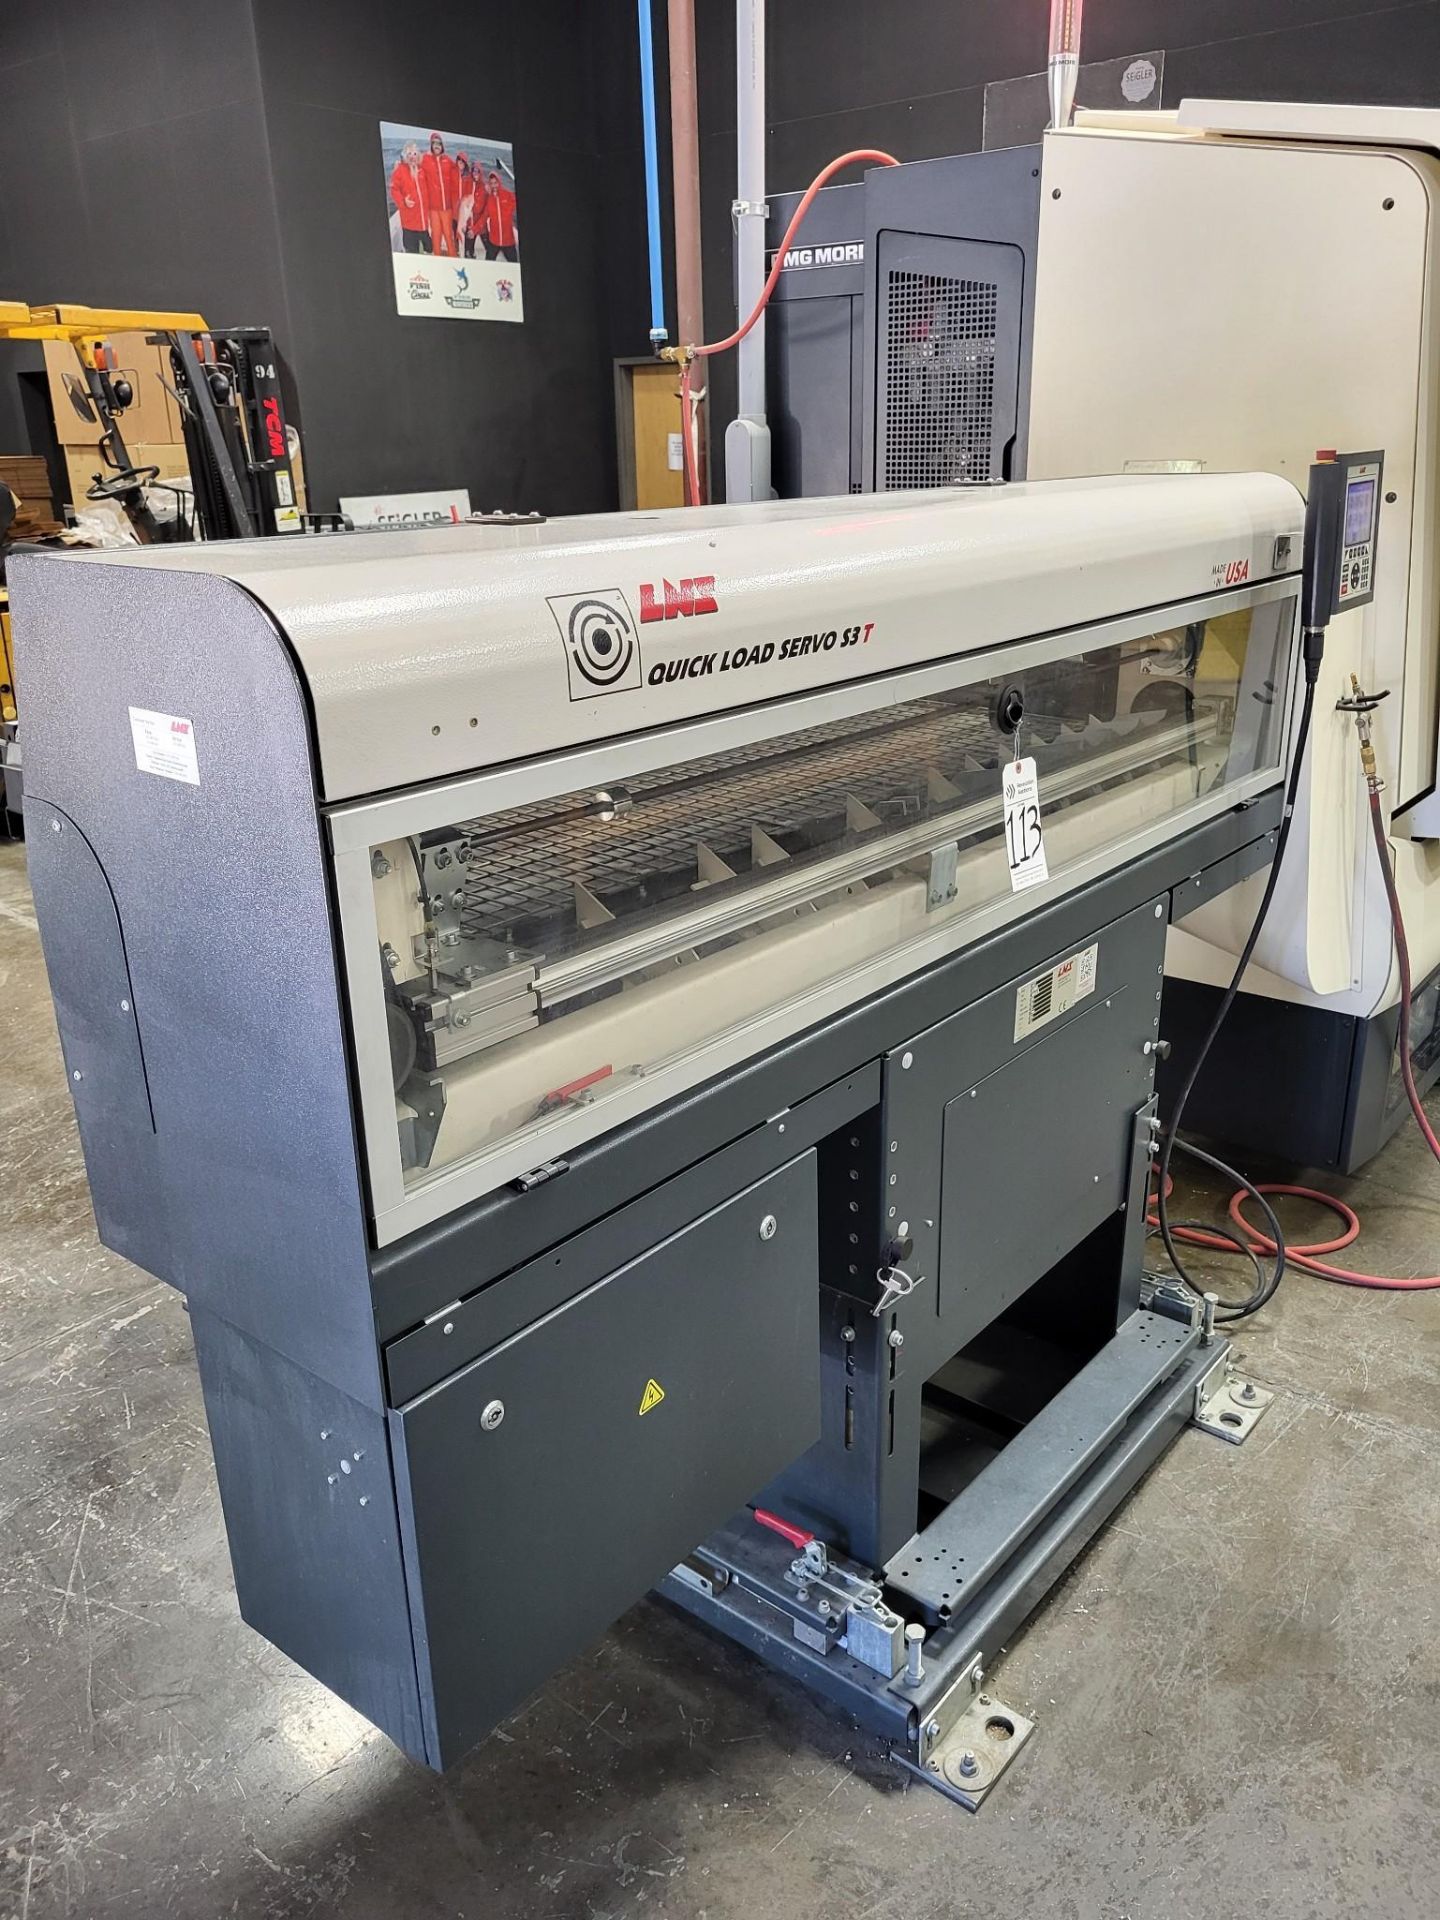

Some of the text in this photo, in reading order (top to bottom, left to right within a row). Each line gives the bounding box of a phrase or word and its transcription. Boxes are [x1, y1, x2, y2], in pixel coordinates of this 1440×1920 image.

[1126, 69, 1153, 81] SEIGLER
[815, 244, 864, 264] MORI
[255, 364, 276, 379] 94
[263, 397, 286, 456] TCM
[1226, 559, 1249, 584] USA
[648, 623, 875, 686] QUICK LOAD SERVO S3 T
[1007, 805, 1042, 869] 113
